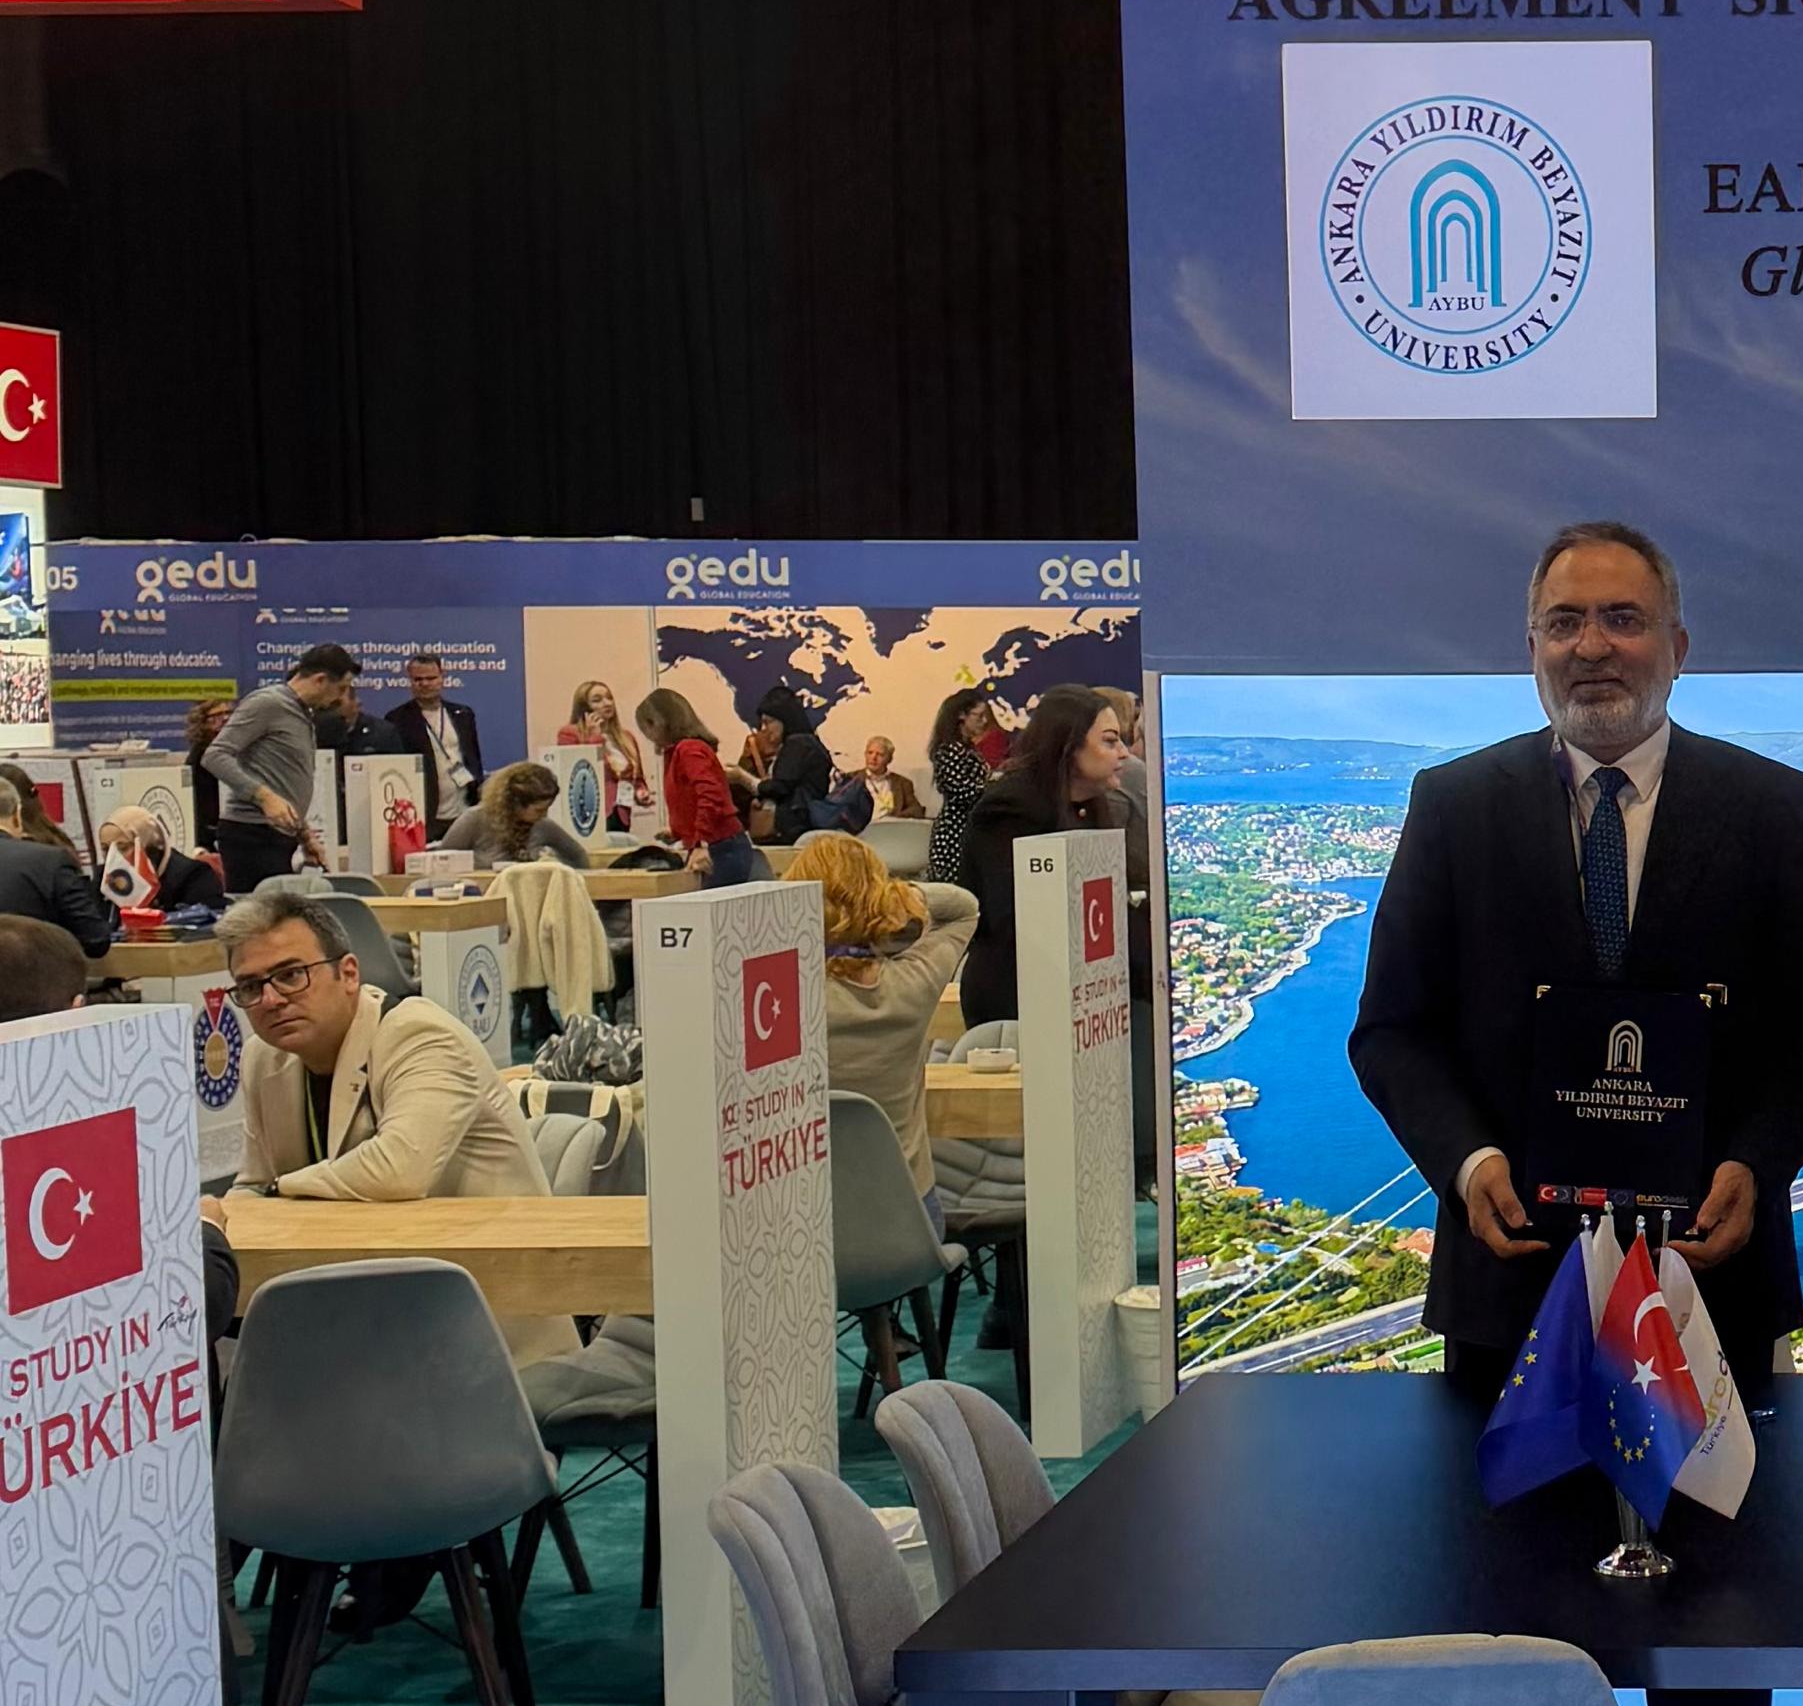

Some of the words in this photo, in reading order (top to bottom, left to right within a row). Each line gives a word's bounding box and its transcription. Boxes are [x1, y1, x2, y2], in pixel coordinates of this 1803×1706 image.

[1329, 156, 1376, 286] ANKARA
[1370, 103, 1530, 156] YILDIRIM
[1531, 145, 1584, 289] BEYAZIT
[1428, 295, 1486, 312] AYBU
[1363, 307, 1553, 371] UNIVERSITY
[136, 551, 258, 603] gedu
[666, 547, 790, 600] gedu
[123, 650, 168, 671] through
[257, 658, 284, 672] and
[363, 658, 401, 674] living
[478, 658, 507, 672] and
[363, 641, 421, 661] through
[423, 641, 496, 655] education
[1030, 858, 1055, 873] B6
[660, 928, 693, 949] B7
[1073, 1001, 1129, 1054] TÜRKİYE
[1555, 1090, 1625, 1106] YILDIRIM
[1628, 1094, 1689, 1109] BEYAZIT
[1592, 1078, 1653, 1093] ANKARA
[745, 1086, 790, 1124] STUDY
[791, 1081, 805, 1109] IN
[1576, 1106, 1666, 1123] UNIVERSITY
[723, 1116, 828, 1197] TÜRKİYE
[9, 1326, 113, 1397] STUDY
[120, 1312, 149, 1357] IN
[0, 1359, 201, 1504] ÜRKİYE
